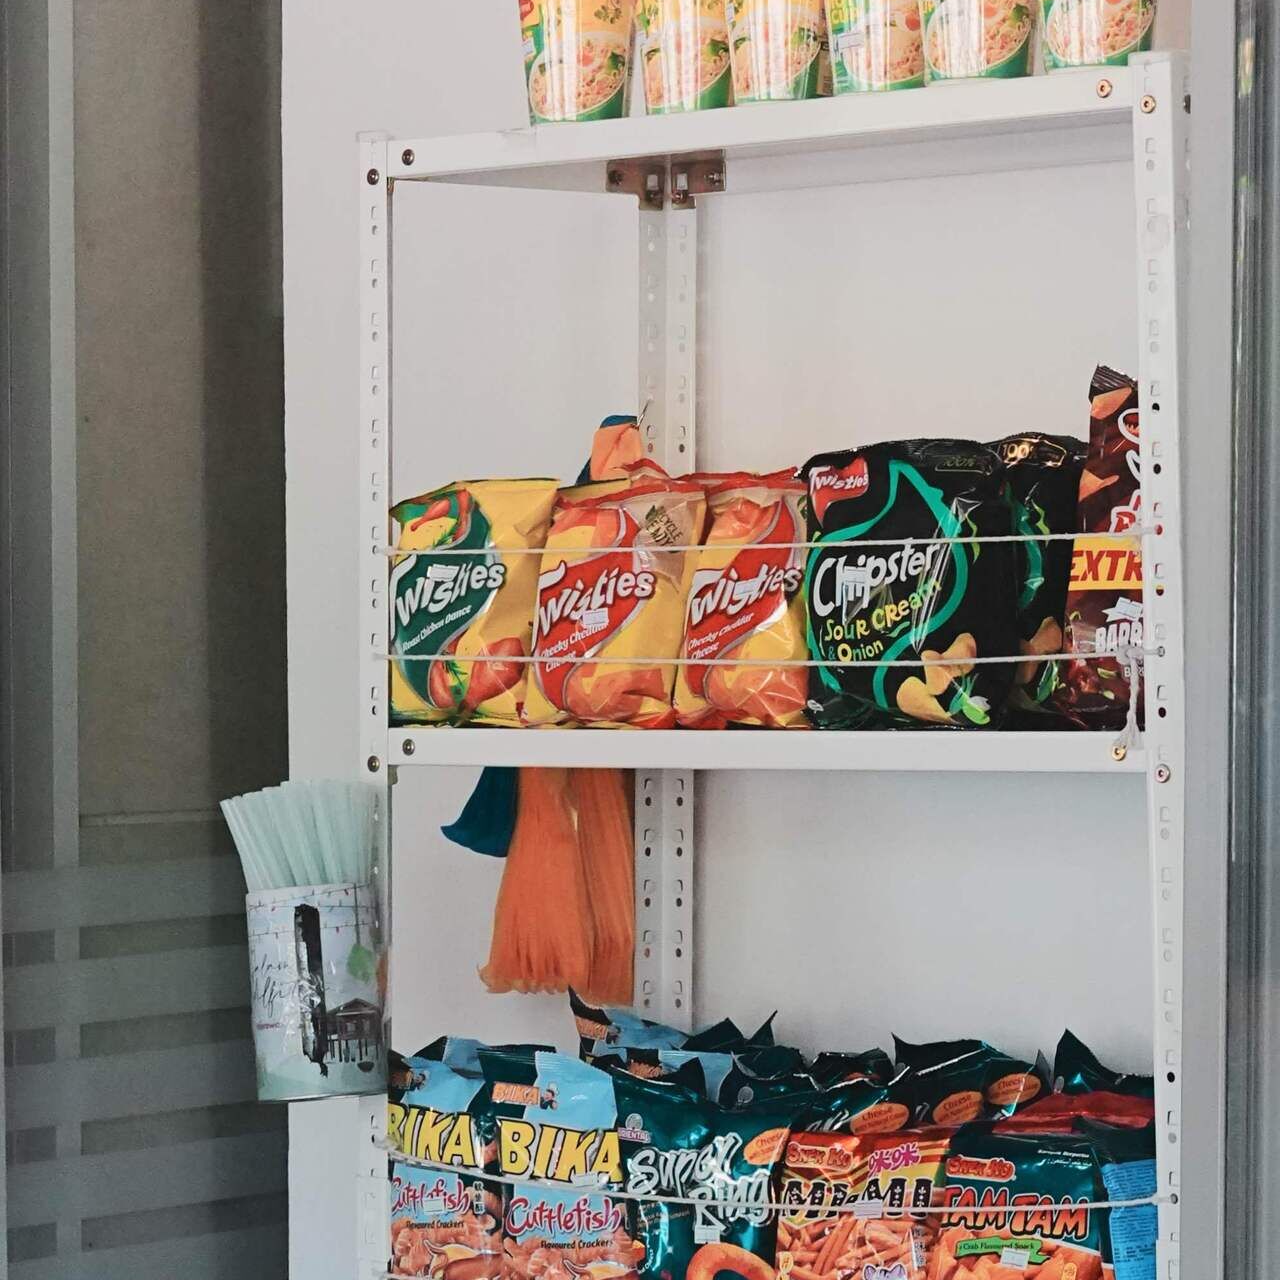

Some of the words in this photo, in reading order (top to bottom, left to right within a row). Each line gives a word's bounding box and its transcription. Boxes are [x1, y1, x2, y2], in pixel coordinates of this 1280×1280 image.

[809, 464, 869, 497] Twisties
[389, 553, 507, 641] Twisties
[531, 561, 656, 656] Twisties
[684, 563, 803, 637] Twisties
[812, 541, 941, 618] Chipster
[499, 1118, 624, 1184] BIKA
[627, 1131, 743, 1202] Super
[504, 1196, 623, 1236] Cuttlefish
[688, 1168, 776, 1236] Ring
[540, 1239, 576, 1250] Flavoured
[577, 1238, 613, 1249] Crackers
